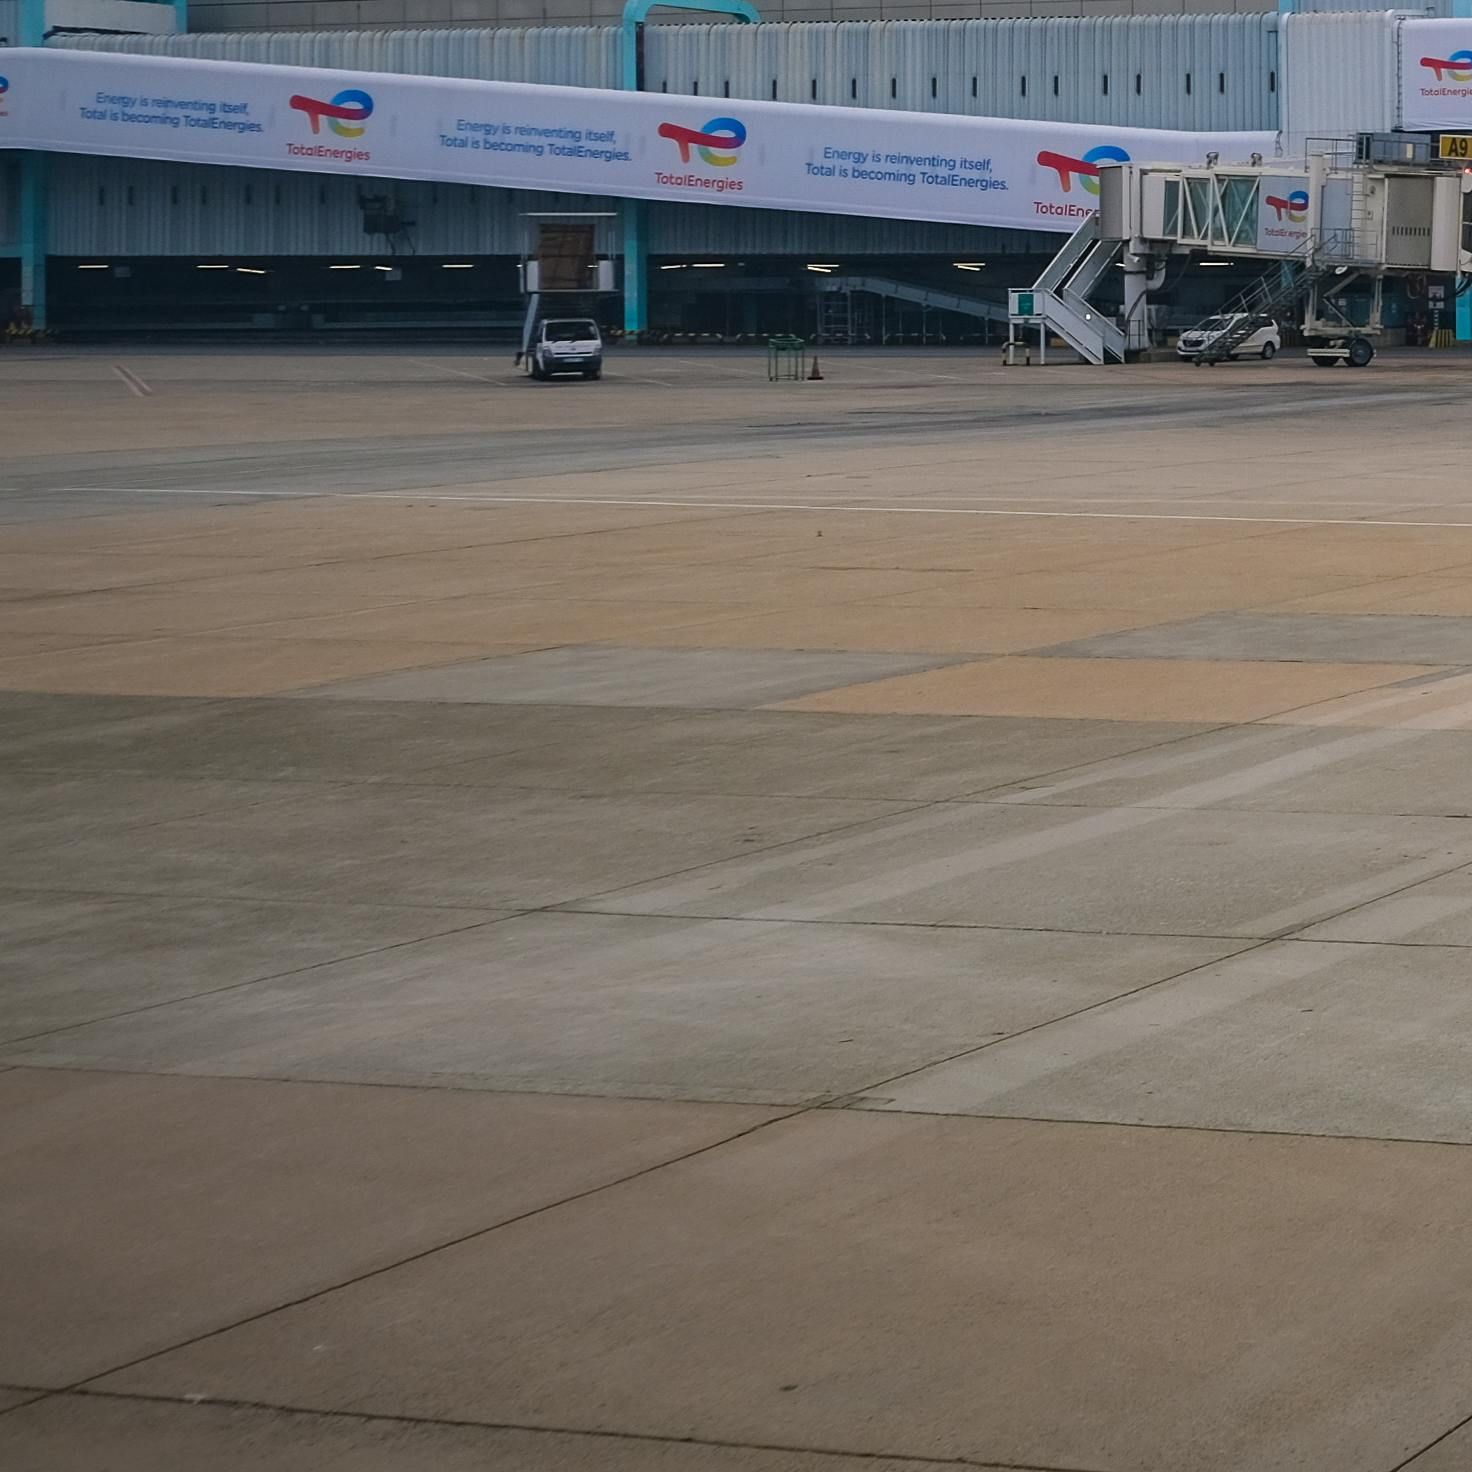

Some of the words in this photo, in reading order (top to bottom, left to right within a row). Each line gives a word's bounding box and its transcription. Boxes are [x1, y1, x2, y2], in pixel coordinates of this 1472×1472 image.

[455, 119, 500, 136] Energy
[500, 123, 512, 134] is
[513, 125, 582, 142] reinventing
[584, 130, 616, 144] itself,
[285, 143, 371, 162] TotalEnergies
[438, 134, 469, 148] Total
[469, 137, 480, 149] is
[482, 137, 544, 156] becoming
[546, 144, 632, 162] TotalEnergies.
[1448, 137, 1468, 157] A9
[823, 147, 869, 164] Energy
[871, 151, 881, 162] is
[884, 152, 956, 171] reinventing
[959, 158, 992, 173] itself,
[653, 172, 744, 192] TotalEnergies
[805, 162, 836, 176] Total
[838, 165, 848, 178] is
[851, 165, 916, 185] becoming
[919, 172, 1008, 191] TotalEnergies.
